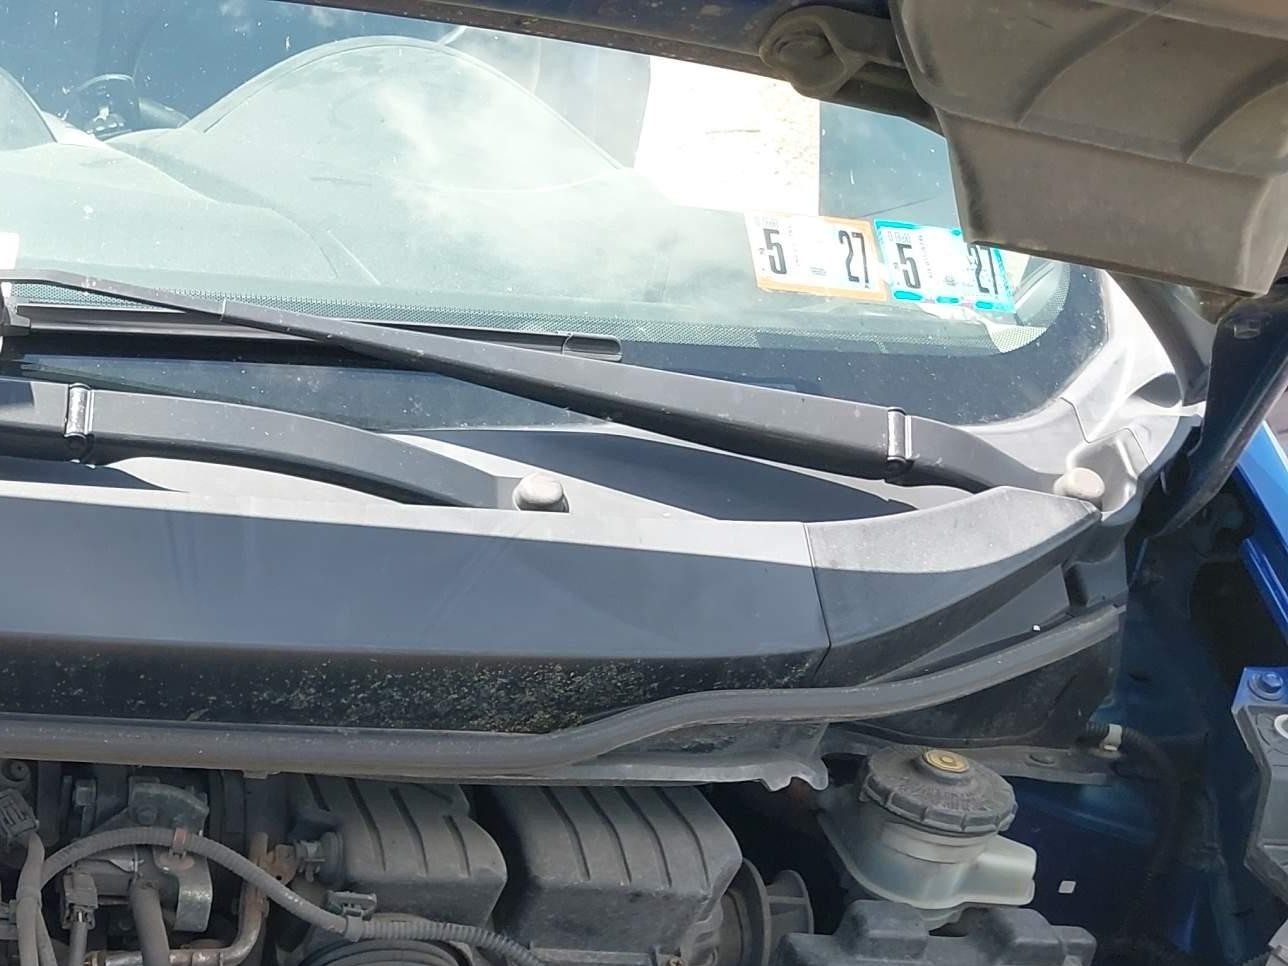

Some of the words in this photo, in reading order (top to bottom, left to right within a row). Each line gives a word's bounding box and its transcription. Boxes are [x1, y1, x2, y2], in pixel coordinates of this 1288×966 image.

[763, 228, 788, 275] 5
[838, 230, 870, 284] 27
[896, 242, 921, 289] 5
[967, 244, 999, 295] 27
